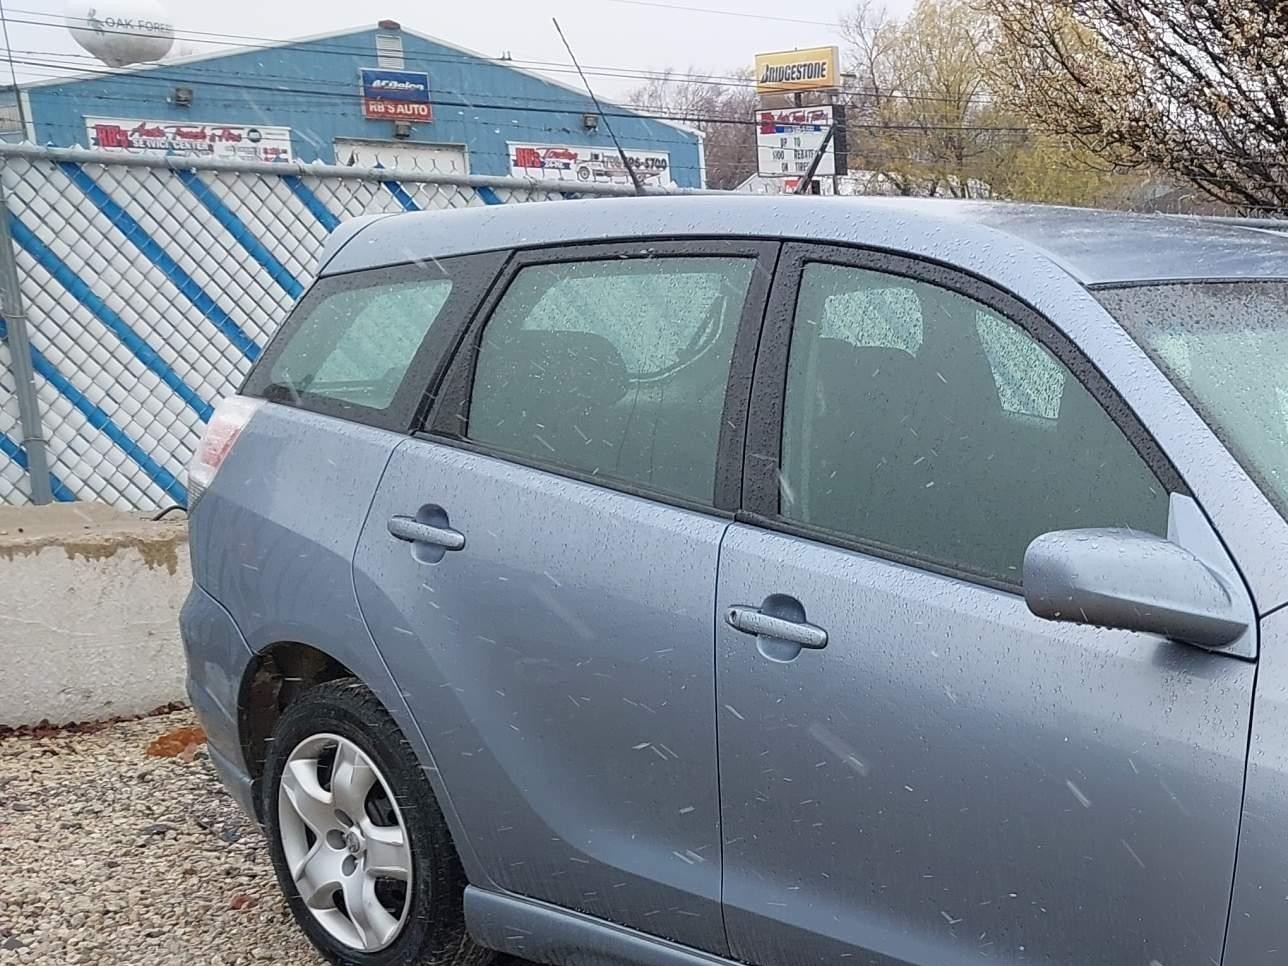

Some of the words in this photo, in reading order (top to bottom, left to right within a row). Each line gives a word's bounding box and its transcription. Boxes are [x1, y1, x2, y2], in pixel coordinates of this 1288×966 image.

[104, 17, 133, 29] OAK
[760, 62, 827, 83] BRIDGESTONE
[396, 103, 428, 115] AUTO
